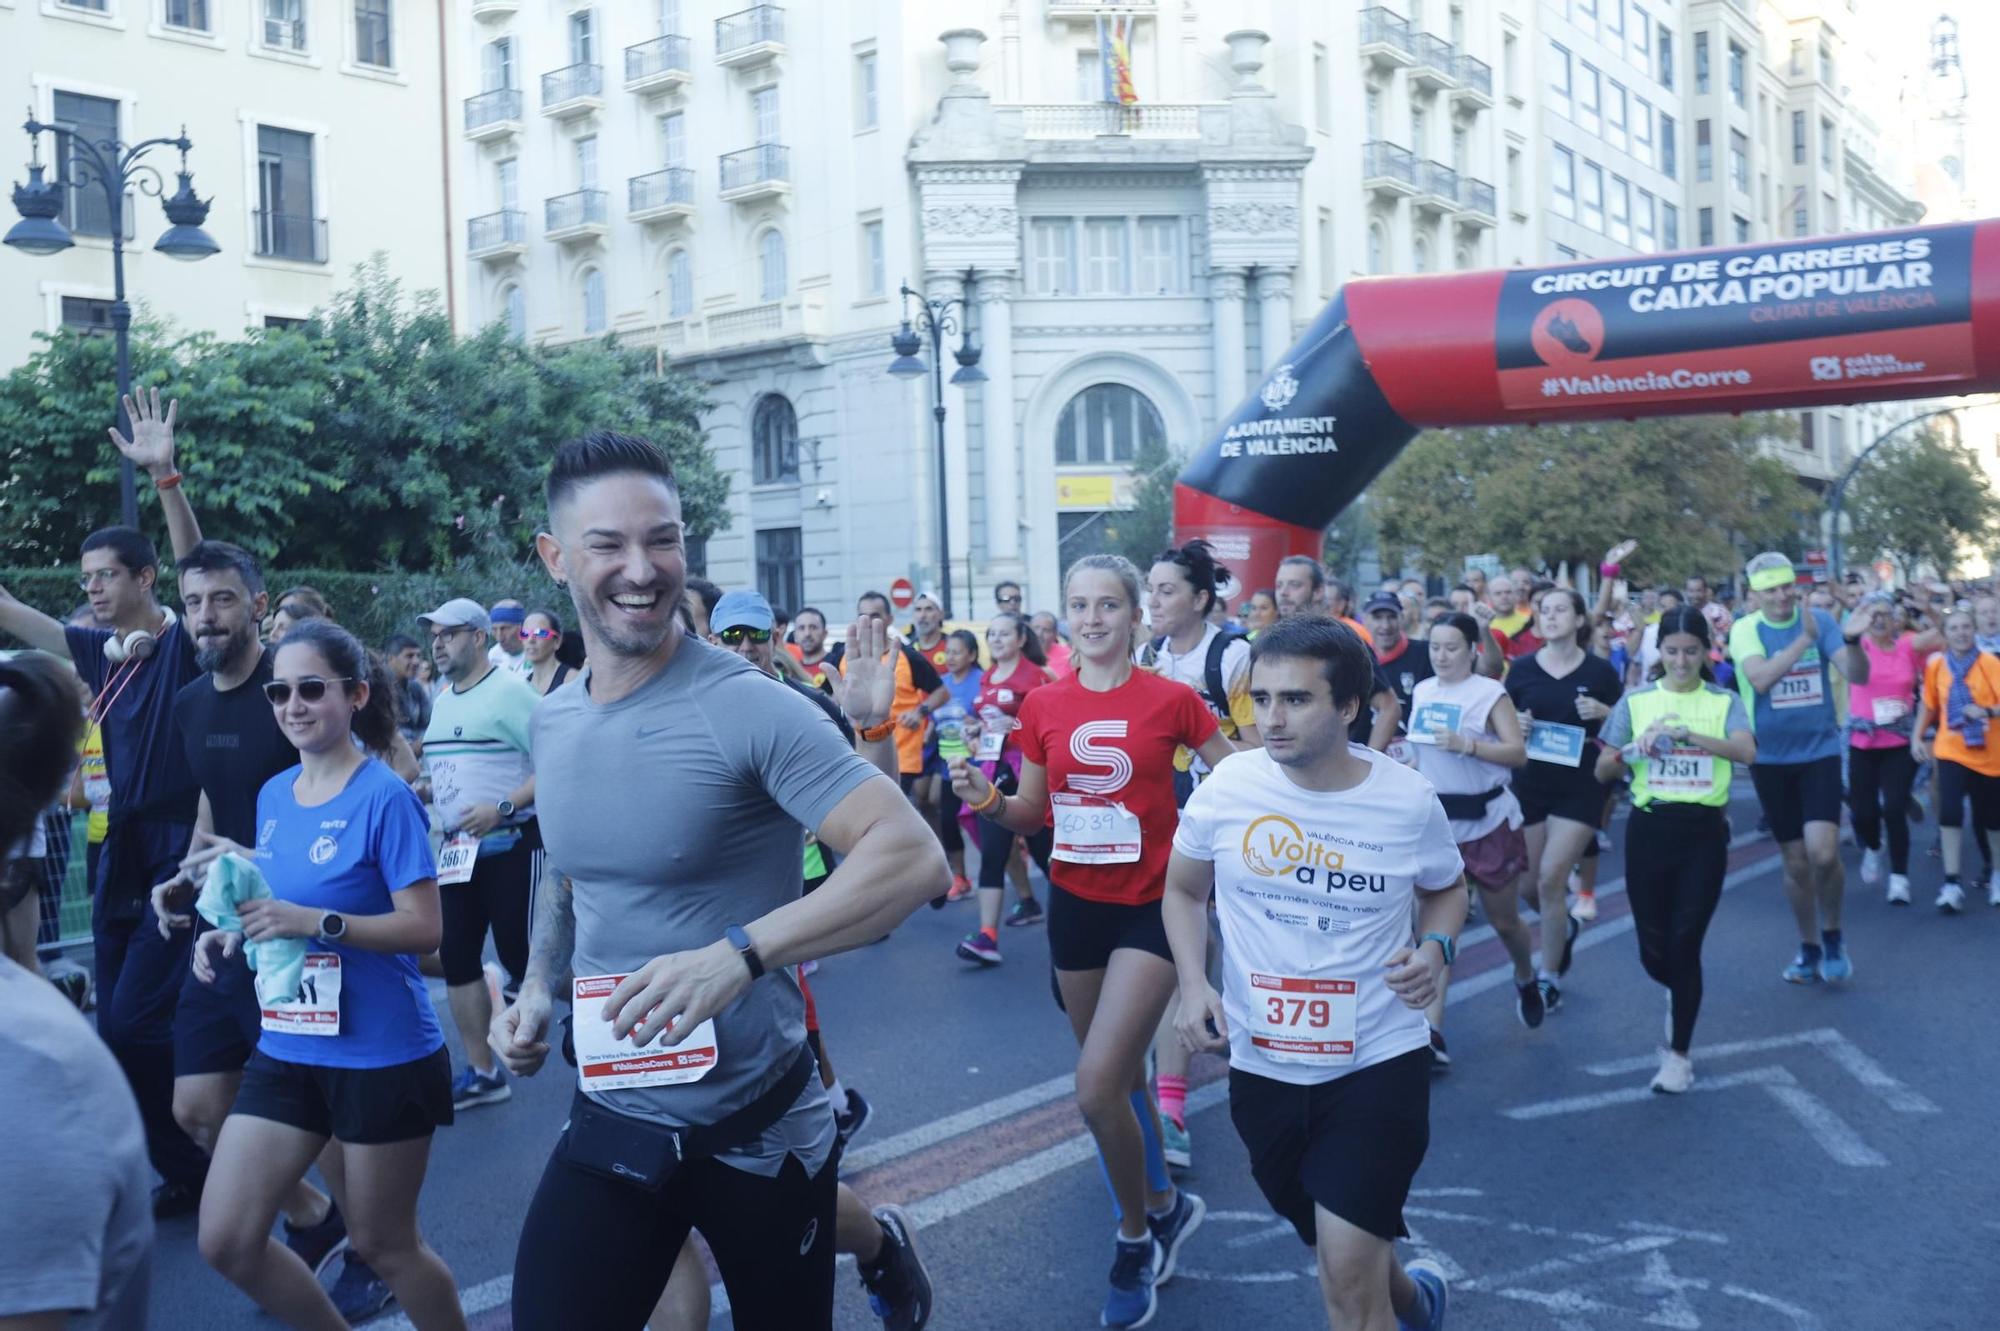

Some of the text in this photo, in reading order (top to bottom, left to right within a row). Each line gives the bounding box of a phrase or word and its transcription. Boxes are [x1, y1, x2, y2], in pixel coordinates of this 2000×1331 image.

[1531, 238, 1931, 294] CIRCUIT DE CARRERES
[1751, 291, 1936, 322] CIUTAT DE VALÈNCIA
[1541, 369, 1752, 396] #ValènciaCorre
[1224, 416, 1337, 440] AJUNTAMENT
[1220, 435, 1338, 457] DE VALÈNCIA
[1657, 758, 1699, 777] 7531
[1062, 813, 1115, 834] 6039
[1268, 833, 1345, 871] Volta
[1357, 841, 1384, 853] 2023
[1296, 866, 1385, 893] a peu
[1266, 996, 1331, 1029] 379
